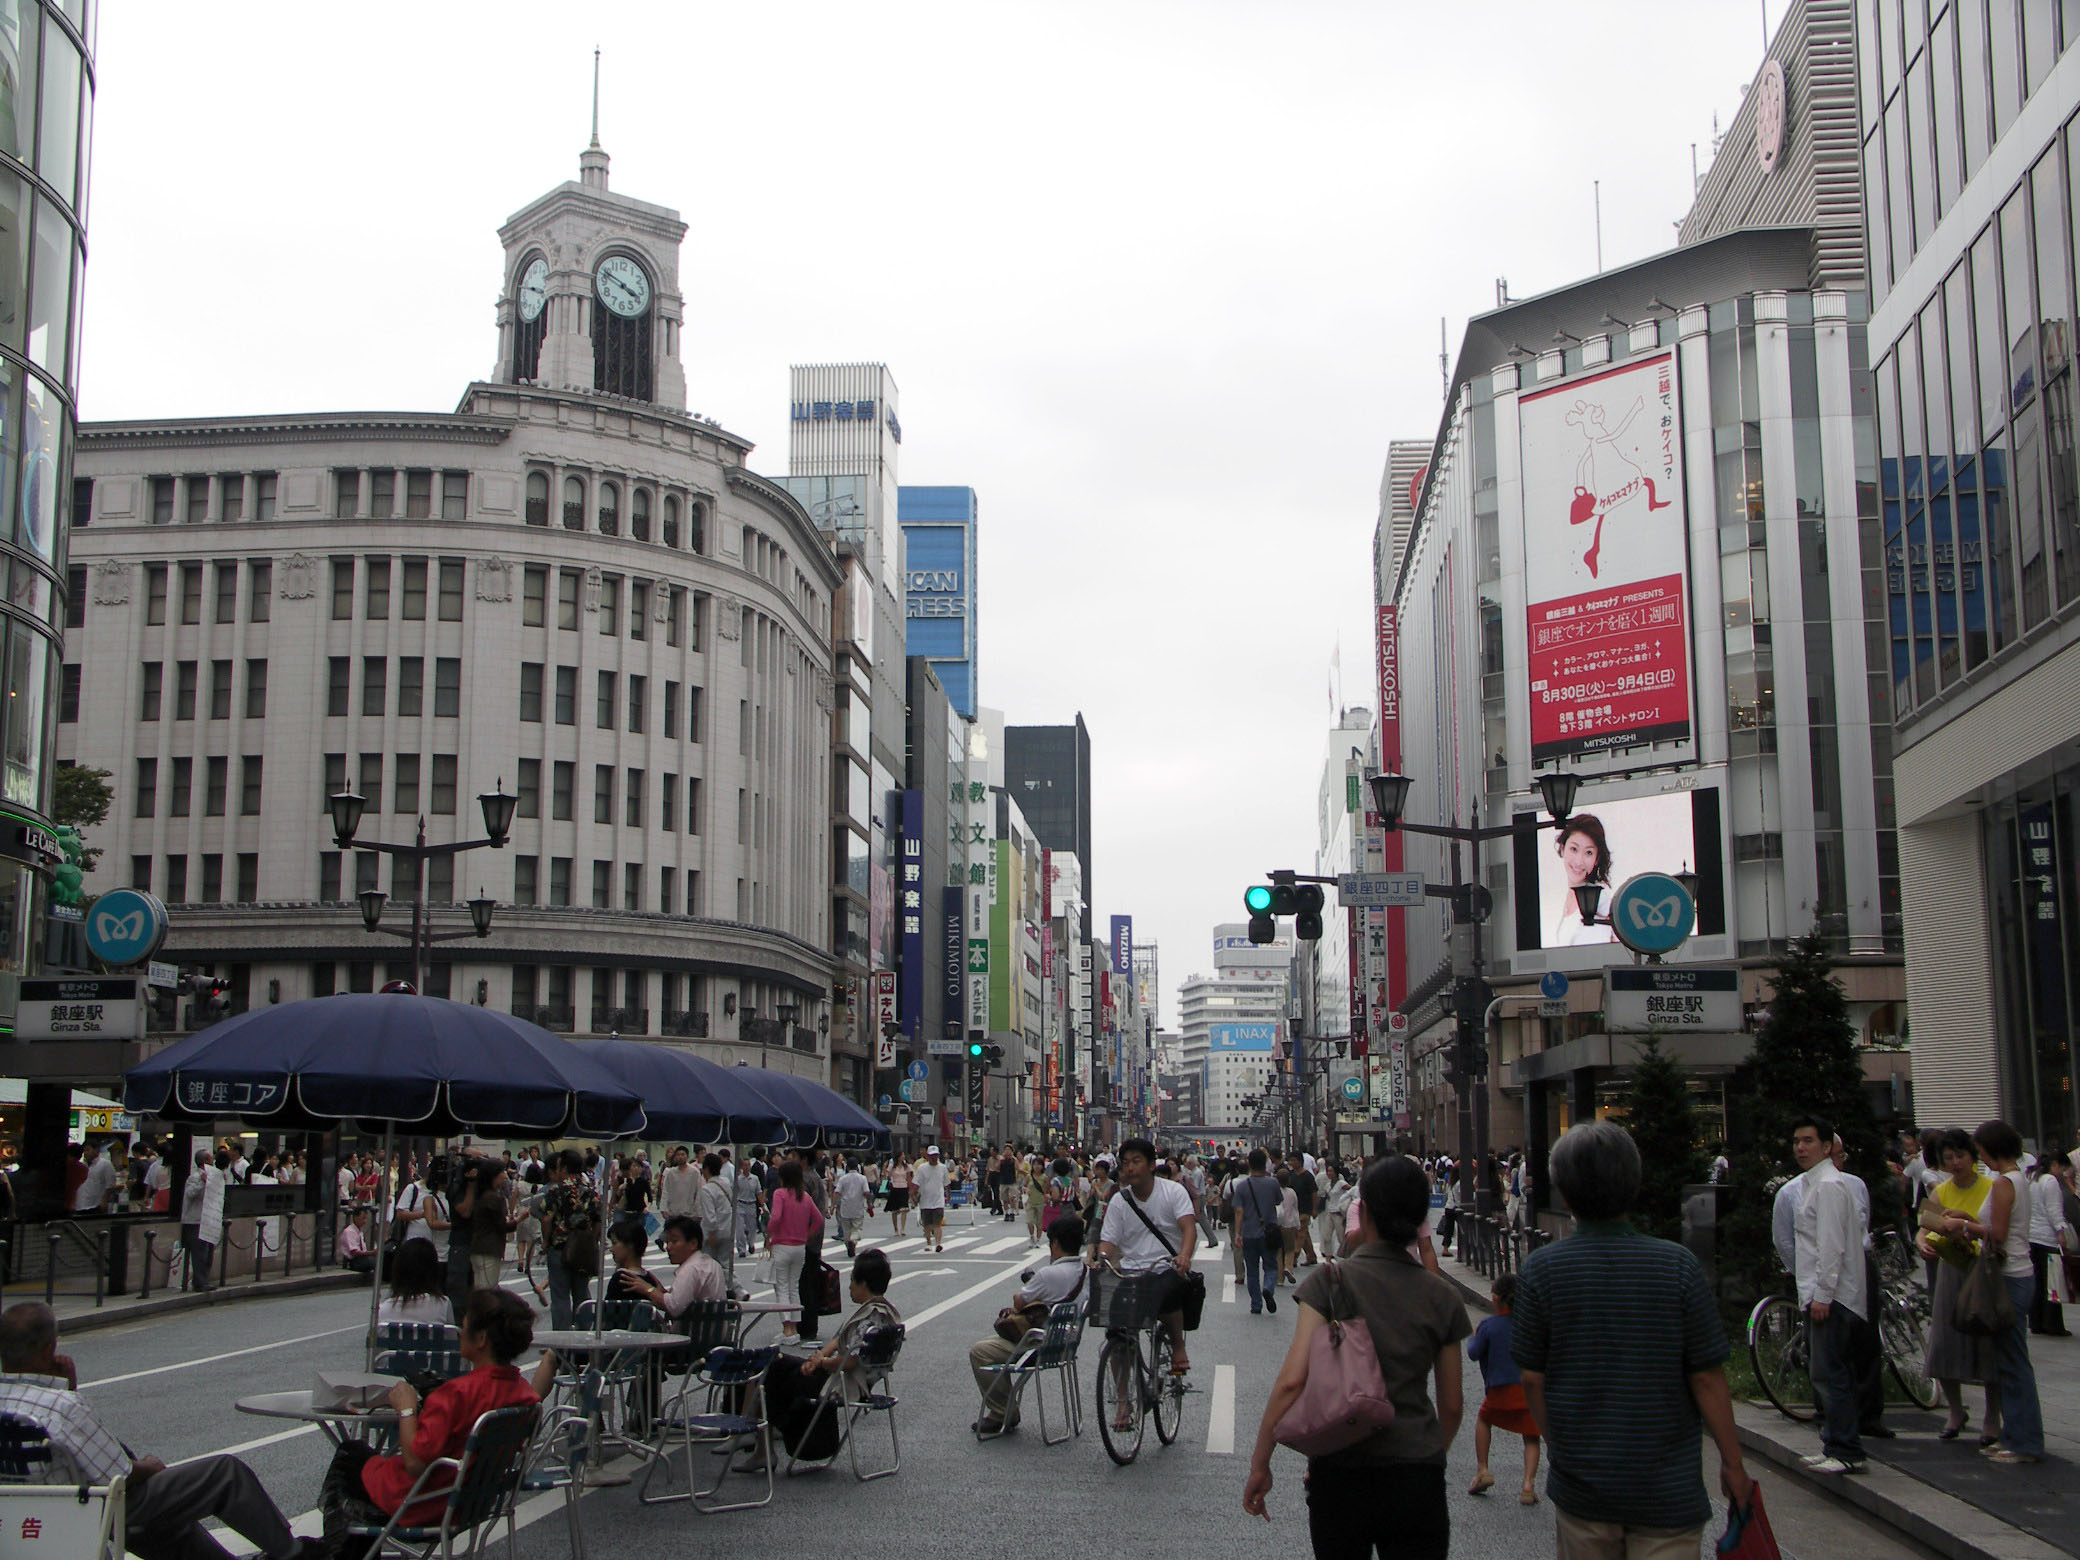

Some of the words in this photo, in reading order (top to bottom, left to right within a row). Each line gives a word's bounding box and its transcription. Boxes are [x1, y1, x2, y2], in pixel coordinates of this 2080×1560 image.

[791, 400, 875, 421] 山野楽器
[1599, 476, 1639, 510] ケイコとマナブ
[1546, 606, 1576, 621] 銀座三越
[1578, 604, 1584, 612] &
[1623, 588, 1664, 603] PRESENTS
[1382, 613, 1396, 720] MITSUKOSHI
[1560, 712, 1574, 723] 8階
[1577, 705, 1612, 720] 催物会場
[1560, 720, 1593, 733] 地下3階
[1584, 734, 1636, 749] MITSUKOSHI
[969, 781, 986, 886] 教文館
[904, 838, 920, 934] 山野楽器
[1344, 881, 1418, 894] 銀座四丁目
[948, 916, 960, 996] MIKIMOTO
[969, 944, 986, 968] 本
[1120, 924, 1129, 970] MIZUHO
[1652, 972, 1696, 982] 東京メトロ
[51, 1005, 104, 1021] 銀座駅
[1646, 995, 1704, 1013] 銀座駅
[50, 1021, 80, 1032] Ginza
[83, 1021, 102, 1032] Sta.
[1648, 1013, 1679, 1024] Ginza
[1682, 1013, 1704, 1024] Sta.
[1236, 1028, 1269, 1039] INAX
[188, 1081, 277, 1105] 銀座コア
[972, 1066, 982, 1113] ヨシノヤ
[21, 1517, 42, 1540] 告
